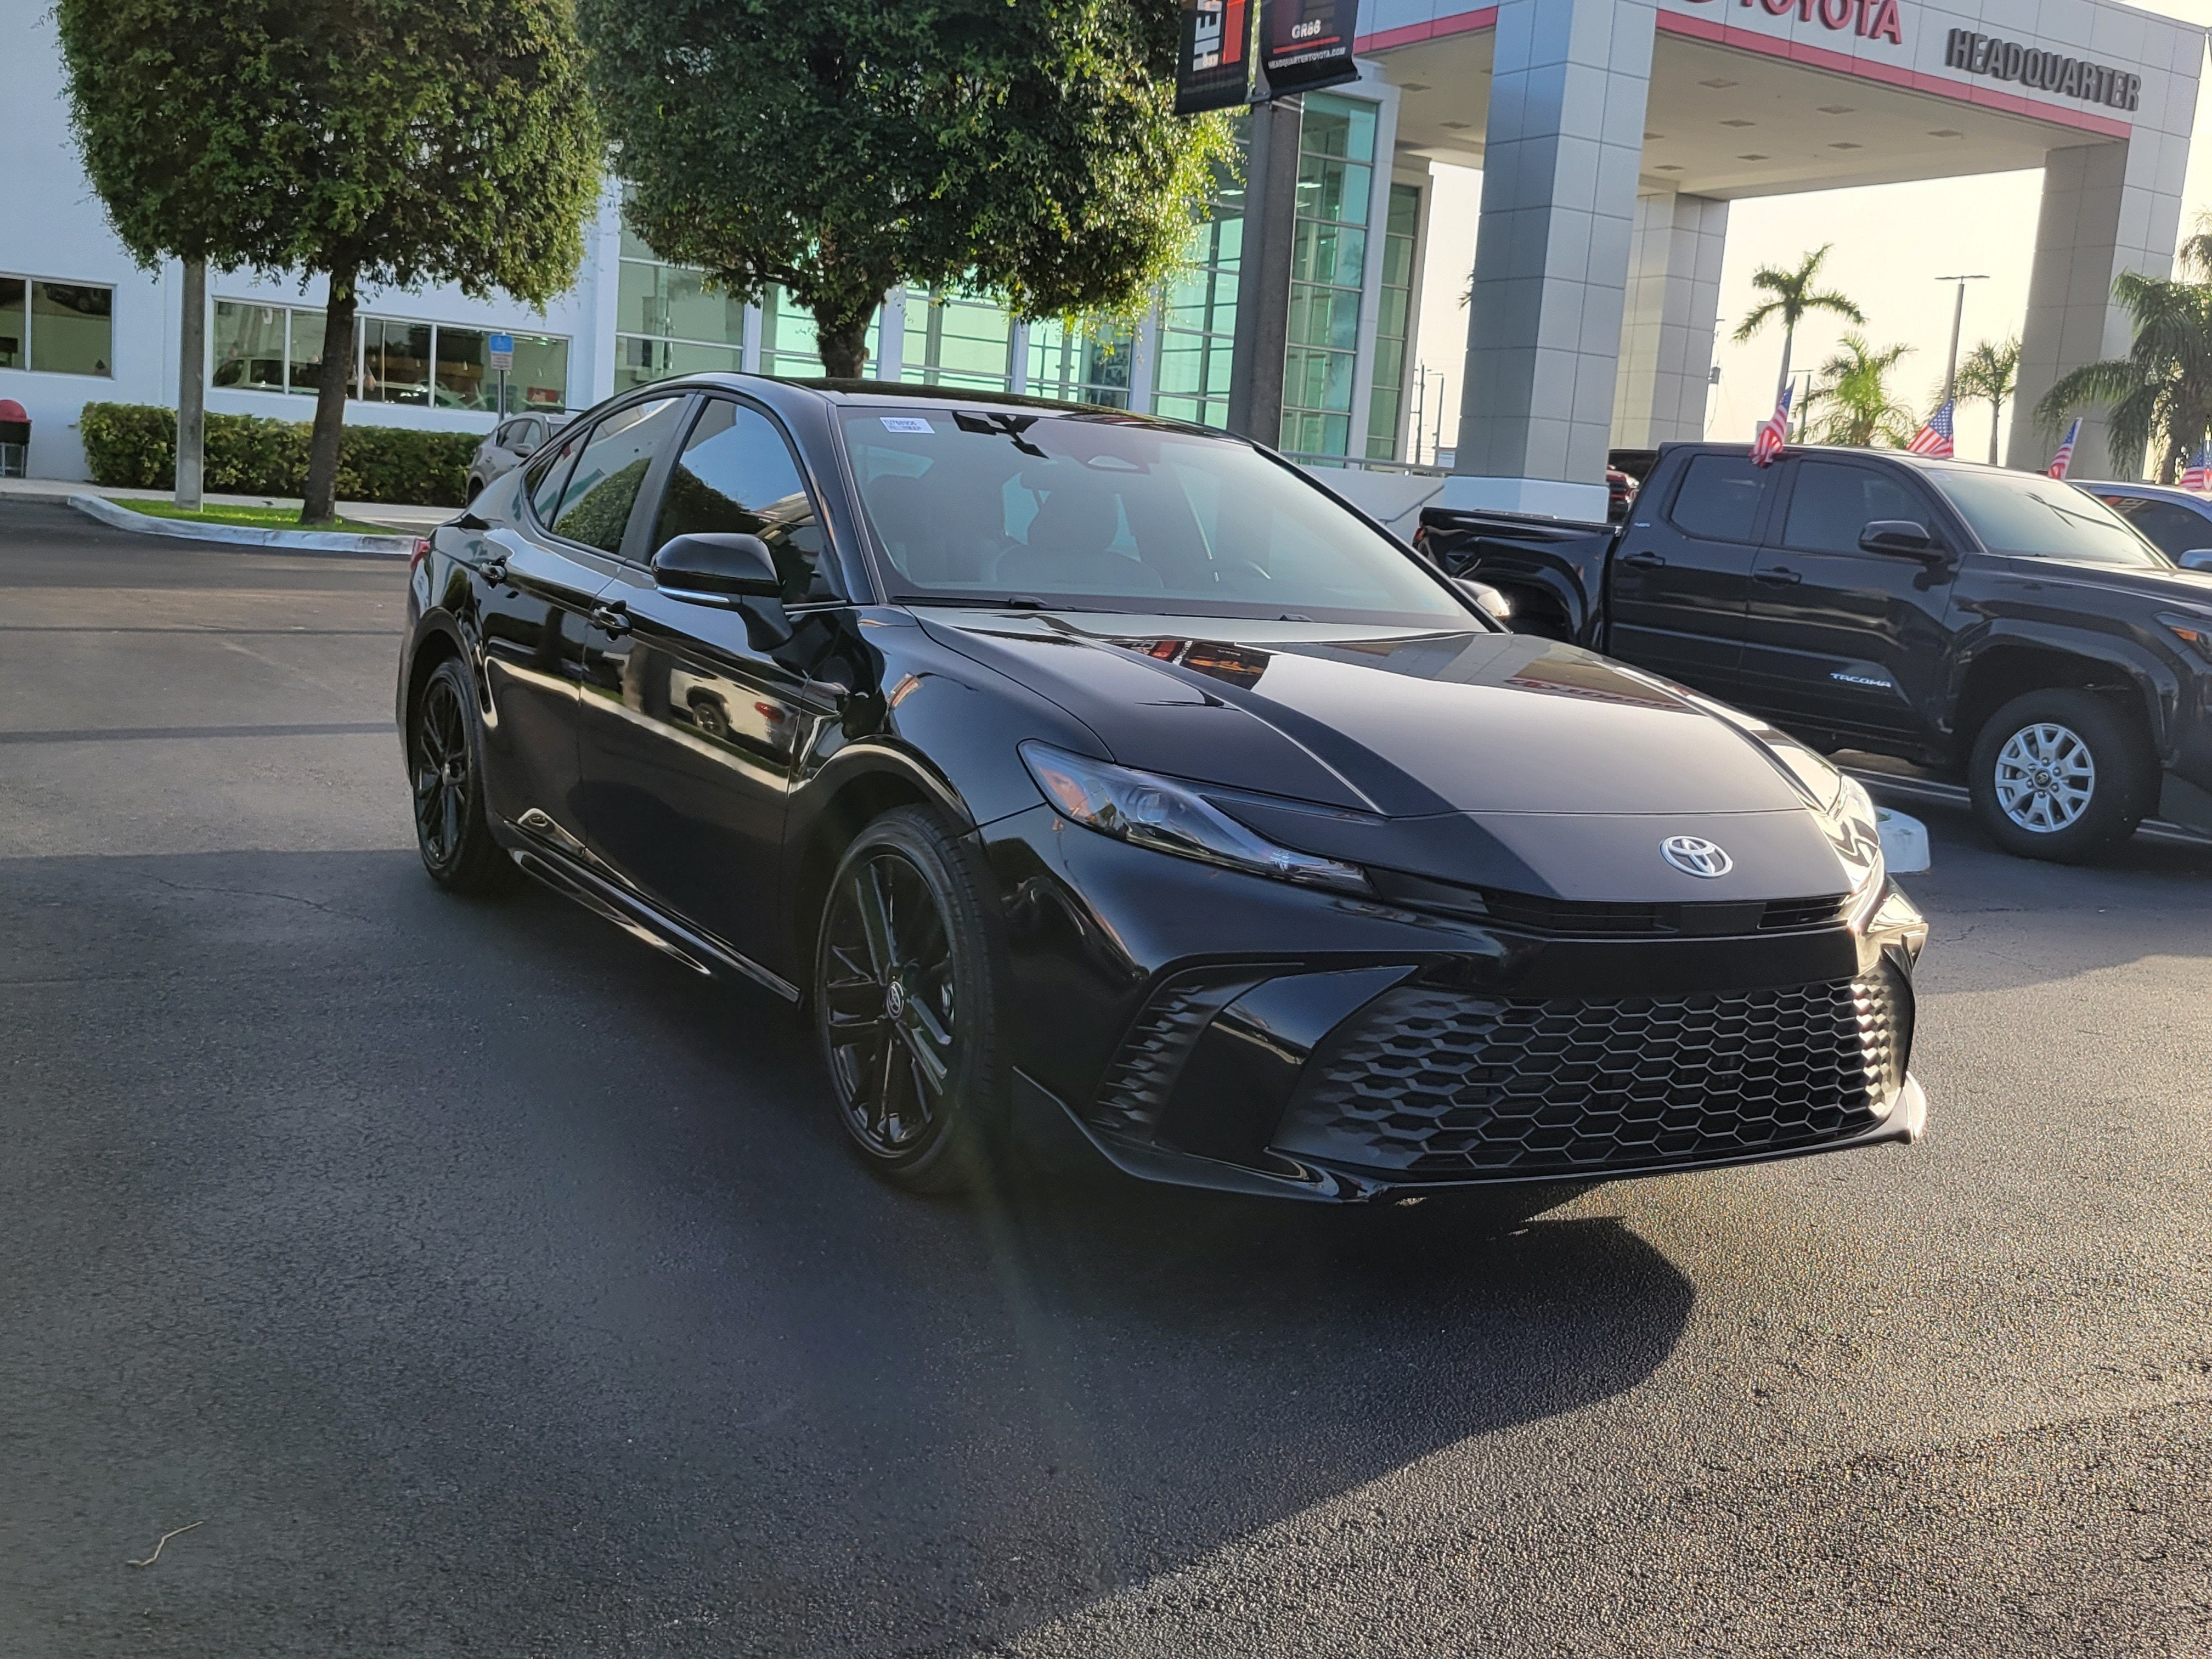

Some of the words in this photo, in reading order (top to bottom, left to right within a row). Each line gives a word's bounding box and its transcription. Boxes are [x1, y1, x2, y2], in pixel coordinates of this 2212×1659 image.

[1740, 0, 1902, 45] YOTA
[1945, 28, 2141, 111] HEADQUARTER
[1830, 673, 1891, 688] TACOMA
